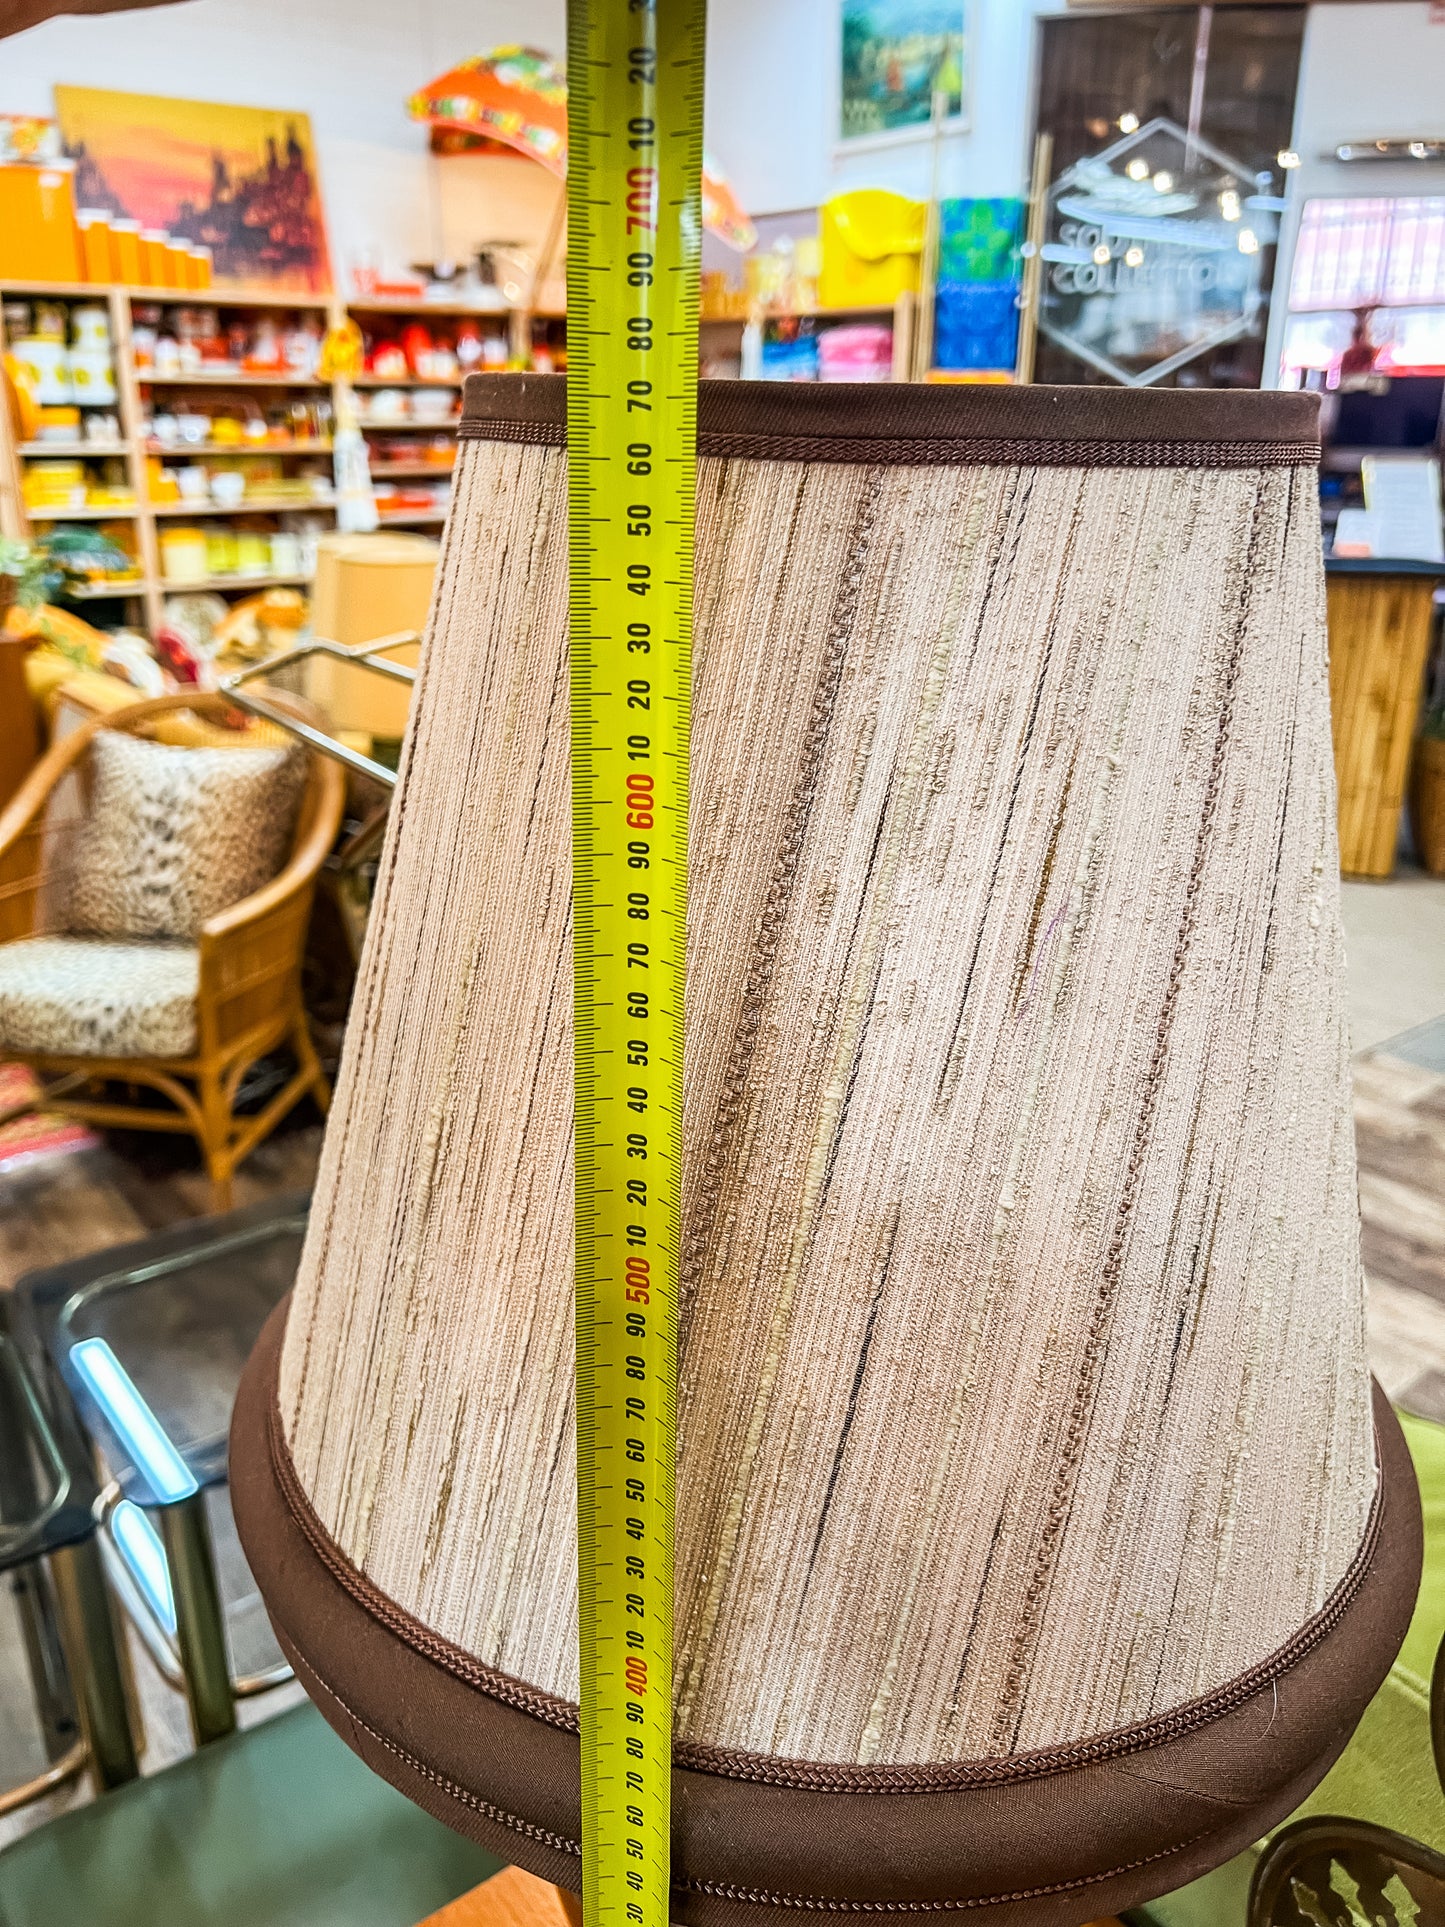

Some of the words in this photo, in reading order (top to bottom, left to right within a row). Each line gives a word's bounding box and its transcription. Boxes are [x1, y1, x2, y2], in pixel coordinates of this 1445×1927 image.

[626, 46, 657, 87] 20
[626, 116, 656, 152] 10
[625, 166, 658, 236] 700
[626, 252, 654, 287] 90
[626, 317, 653, 351] 80
[626, 380, 653, 413] 70
[626, 443, 652, 476] 60
[626, 504, 652, 537] 50
[626, 564, 652, 597] 40
[626, 622, 651, 654] 30
[626, 679, 651, 711] 20
[626, 735, 651, 761] 10
[625, 773, 655, 830] 600
[627, 841, 650, 870] 90
[627, 892, 650, 921] 80
[626, 942, 650, 969] 70
[626, 991, 649, 1019] 60
[626, 1039, 649, 1067] 50
[626, 1086, 649, 1114] 40
[626, 1133, 648, 1161] 30
[626, 1179, 648, 1207] 20
[625, 1224, 647, 1247] 10
[624, 1256, 651, 1305] 500
[625, 1312, 646, 1338] 90
[625, 1355, 646, 1381] 80
[625, 1396, 646, 1422] 70
[625, 1437, 646, 1463] 60
[625, 1477, 645, 1503] 50
[625, 1517, 645, 1541] 40
[625, 1555, 645, 1580] 30
[625, 1593, 645, 1618] 20
[625, 1630, 645, 1650] 10
[625, 1656, 649, 1697] 400
[625, 1701, 644, 1725] 90
[625, 1736, 644, 1760] 80
[625, 1771, 644, 1793] 70
[625, 1805, 644, 1827] 60
[626, 1838, 644, 1861] 50
[626, 1870, 644, 1892] 40
[626, 1902, 644, 1924] 30
